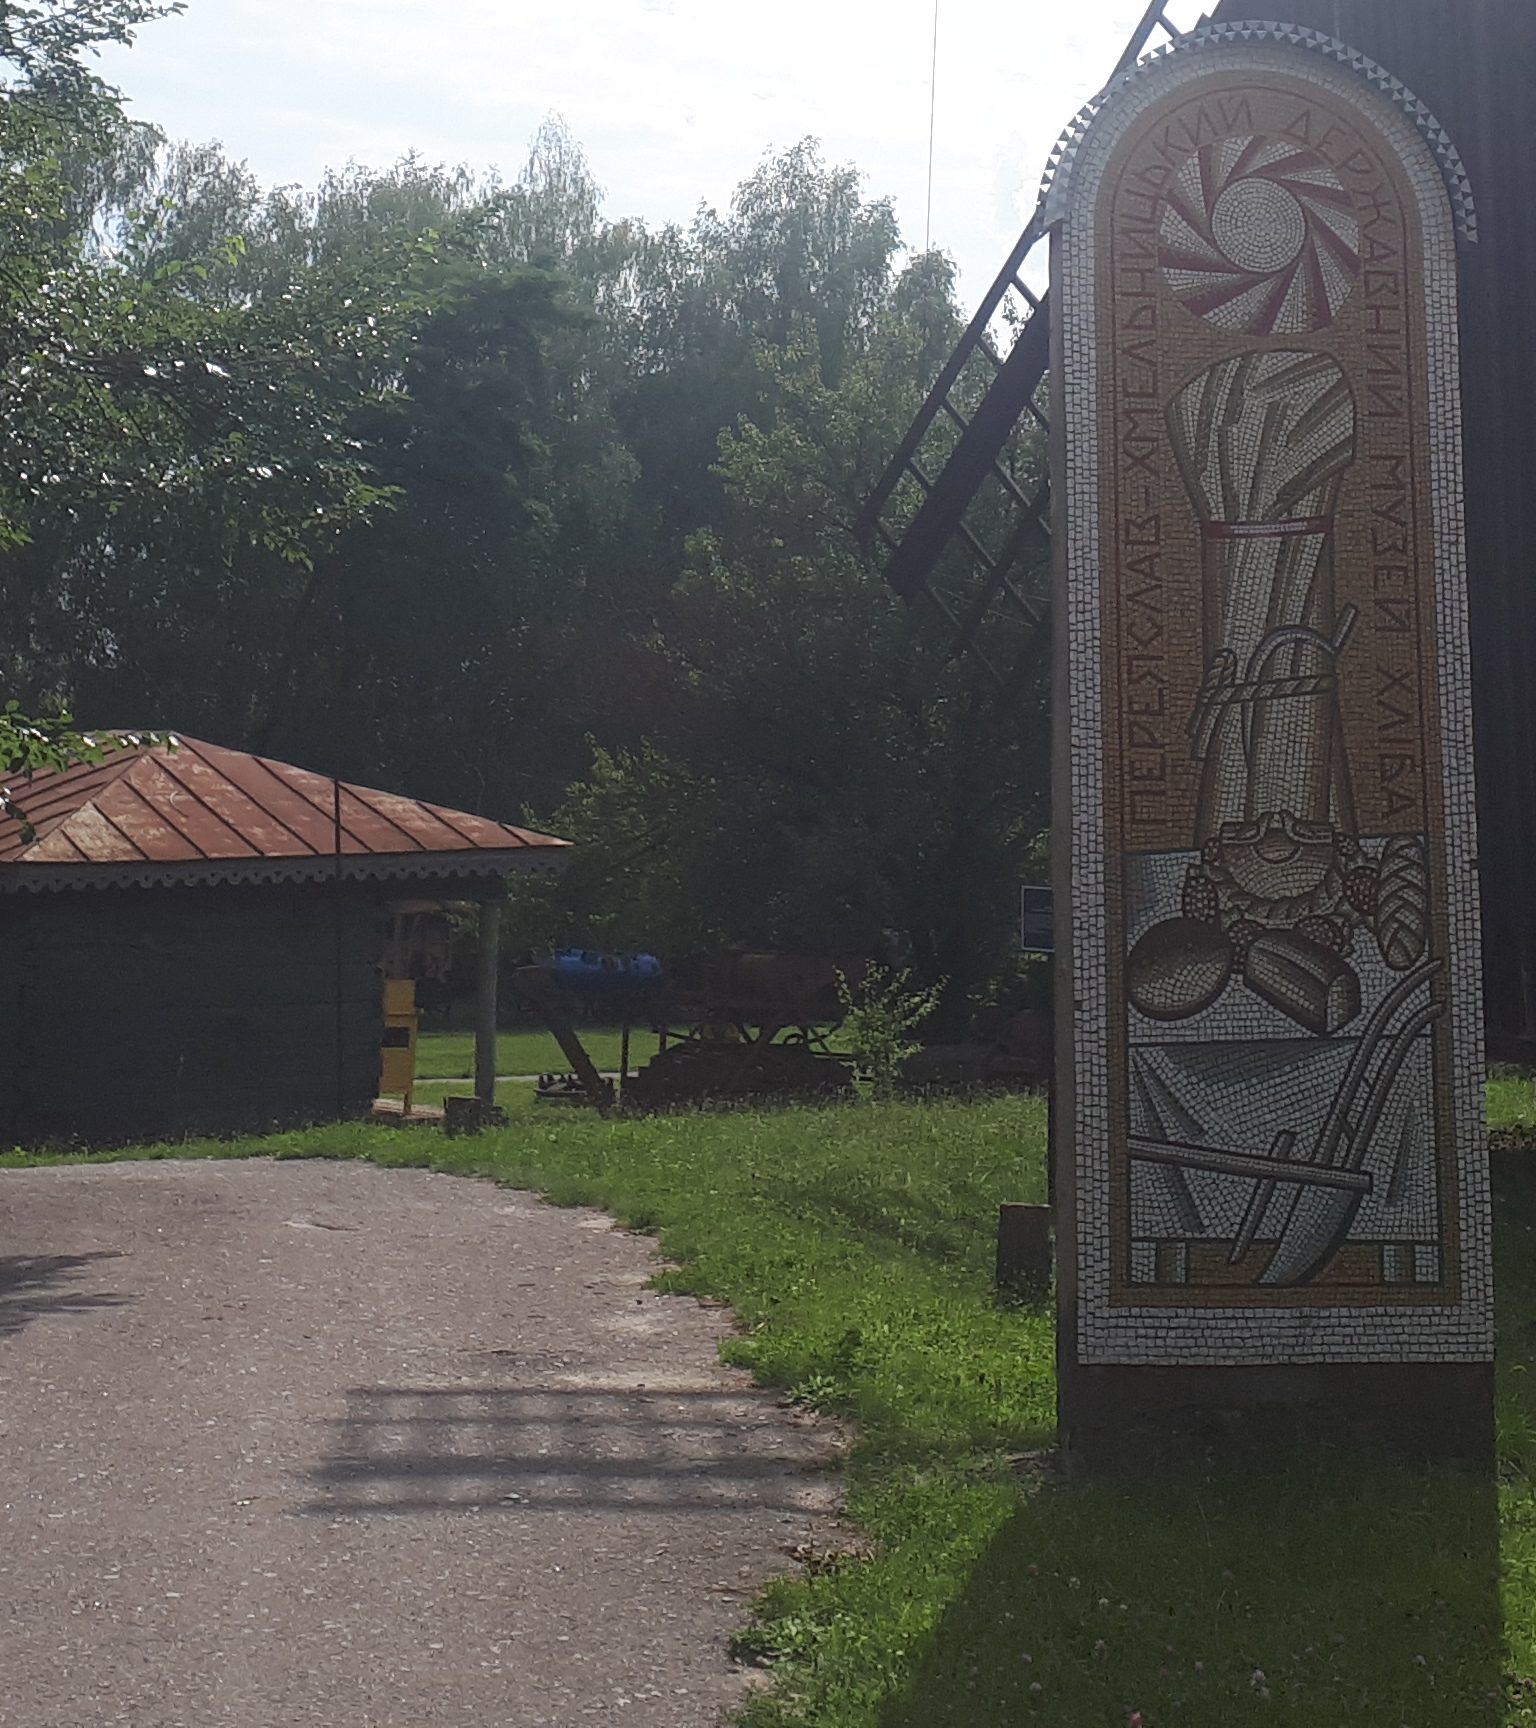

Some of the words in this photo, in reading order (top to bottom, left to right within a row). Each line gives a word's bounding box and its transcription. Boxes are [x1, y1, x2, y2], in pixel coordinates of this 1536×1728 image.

[1282, 108, 1402, 417] ДЕРЖАВНИЙ
[1367, 453, 1413, 632] МУЗЕЙ
[1375, 667, 1418, 820] ХЛІБА
